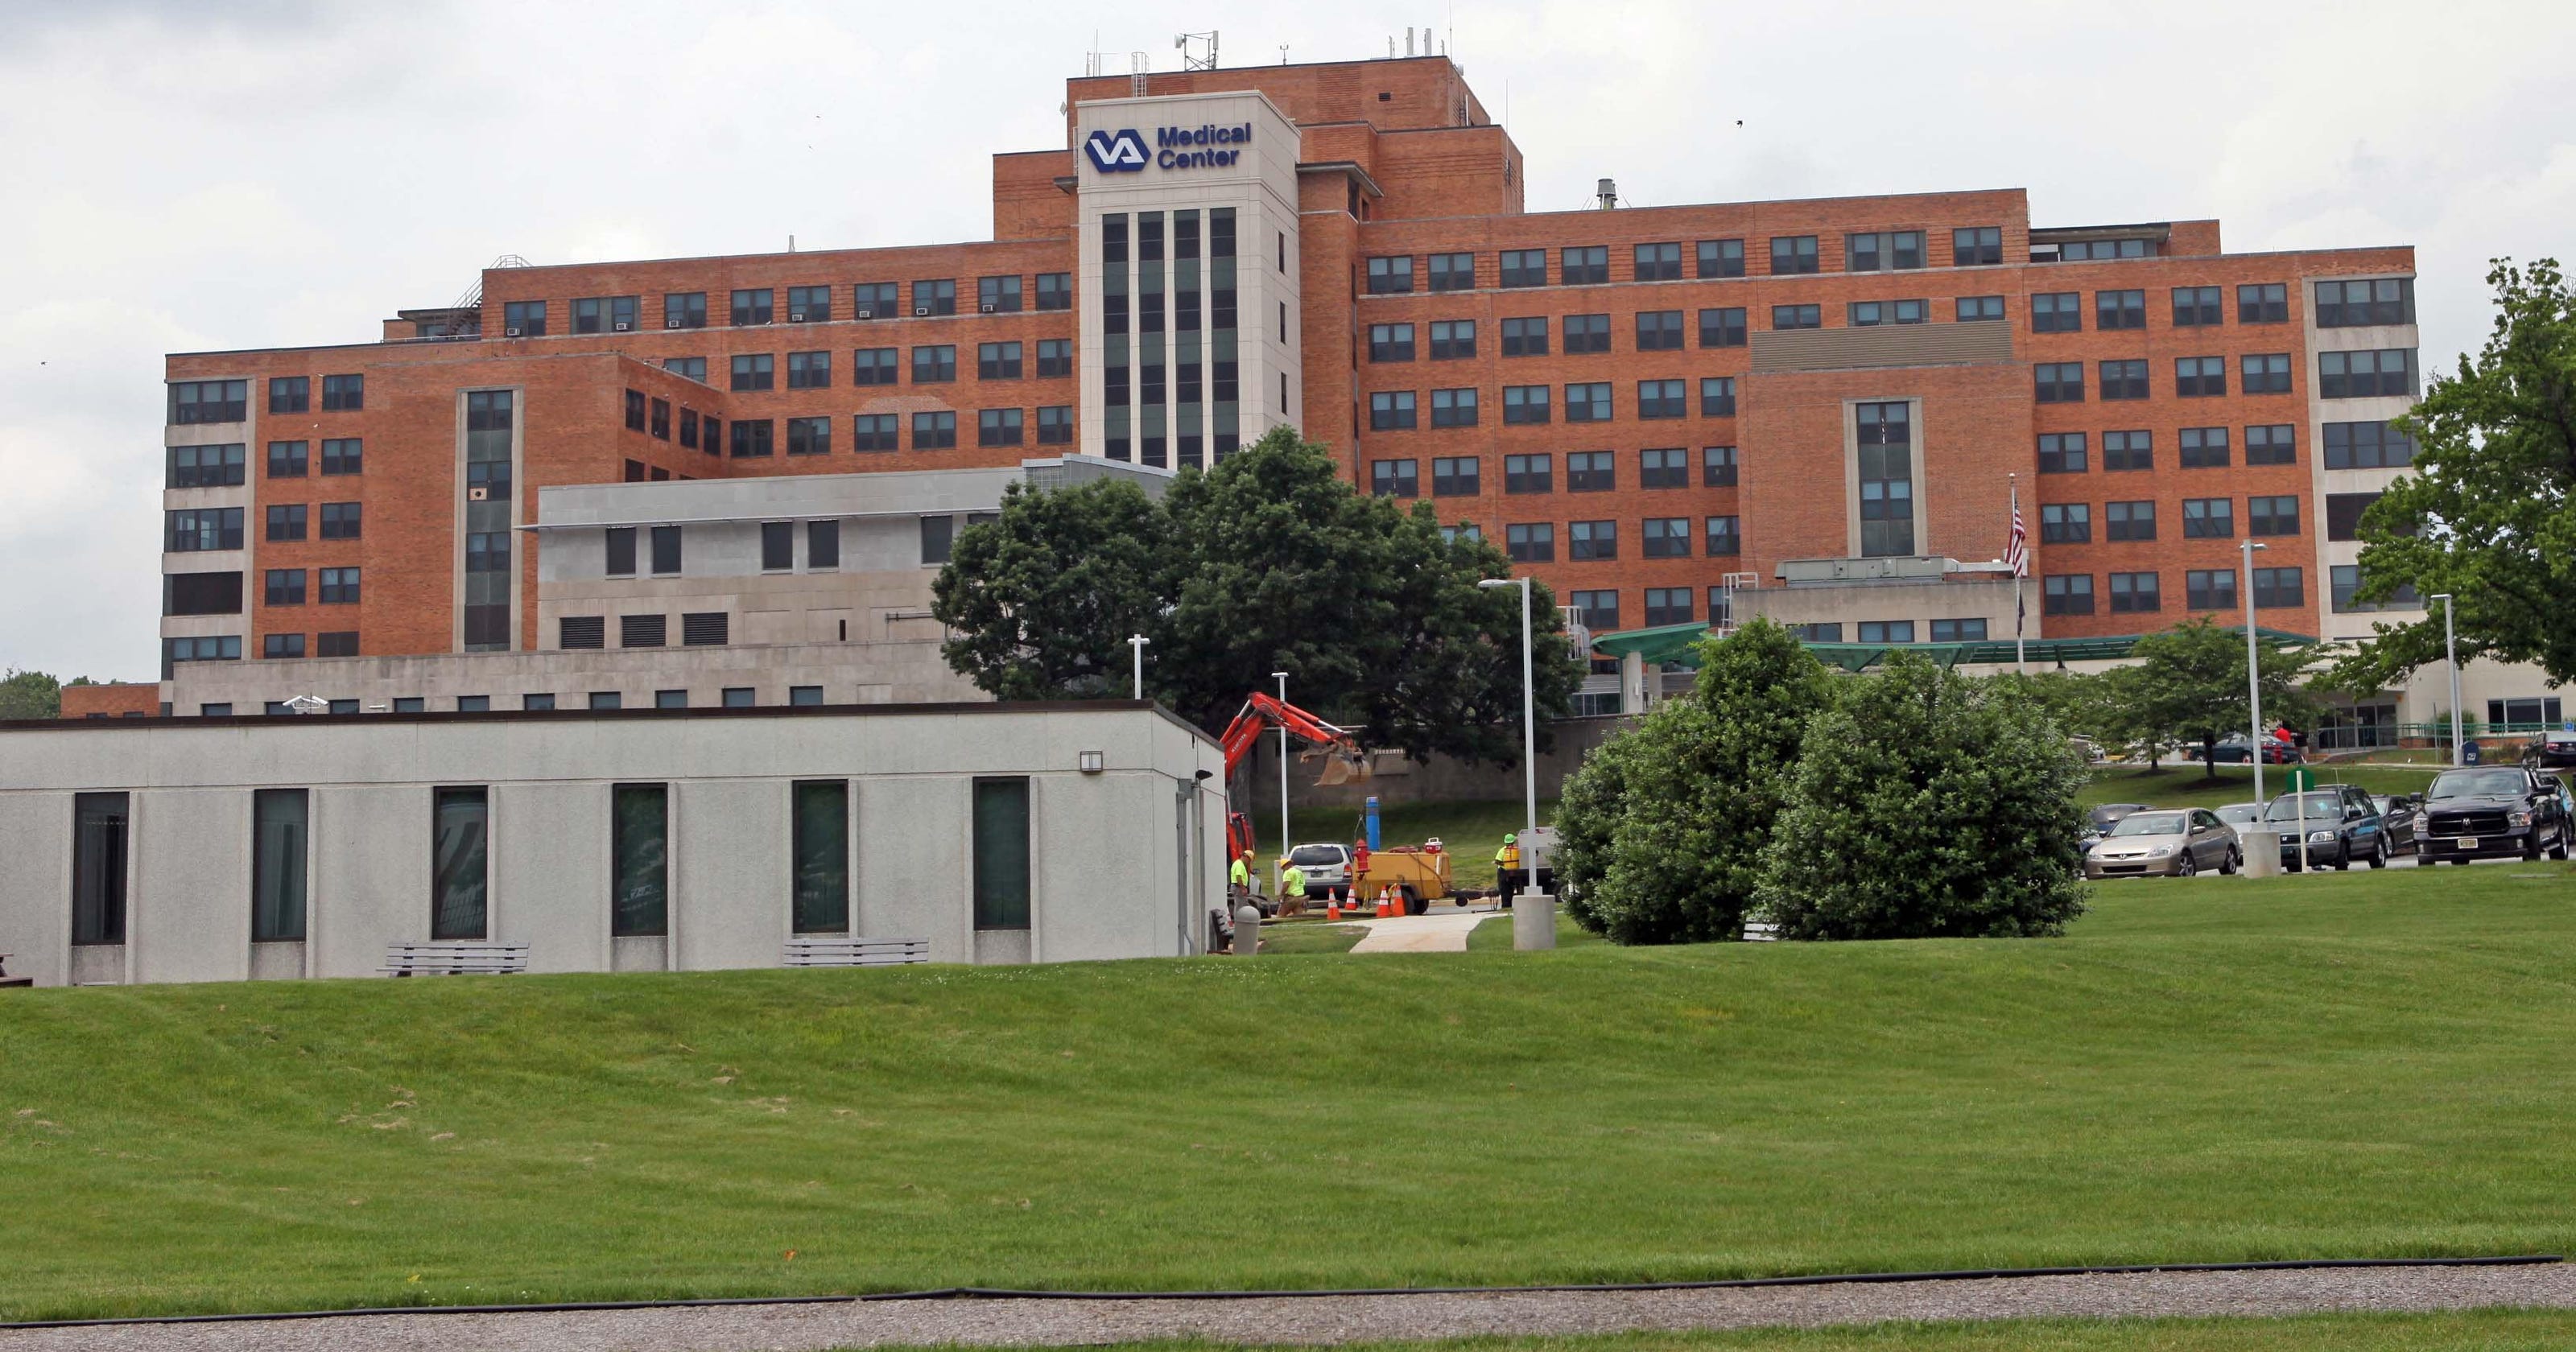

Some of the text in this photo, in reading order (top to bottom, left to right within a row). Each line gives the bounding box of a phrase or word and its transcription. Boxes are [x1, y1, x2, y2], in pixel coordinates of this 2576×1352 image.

[1158, 122, 1252, 146] Medical
[1090, 137, 1145, 164] VA
[1158, 148, 1240, 169] Center
